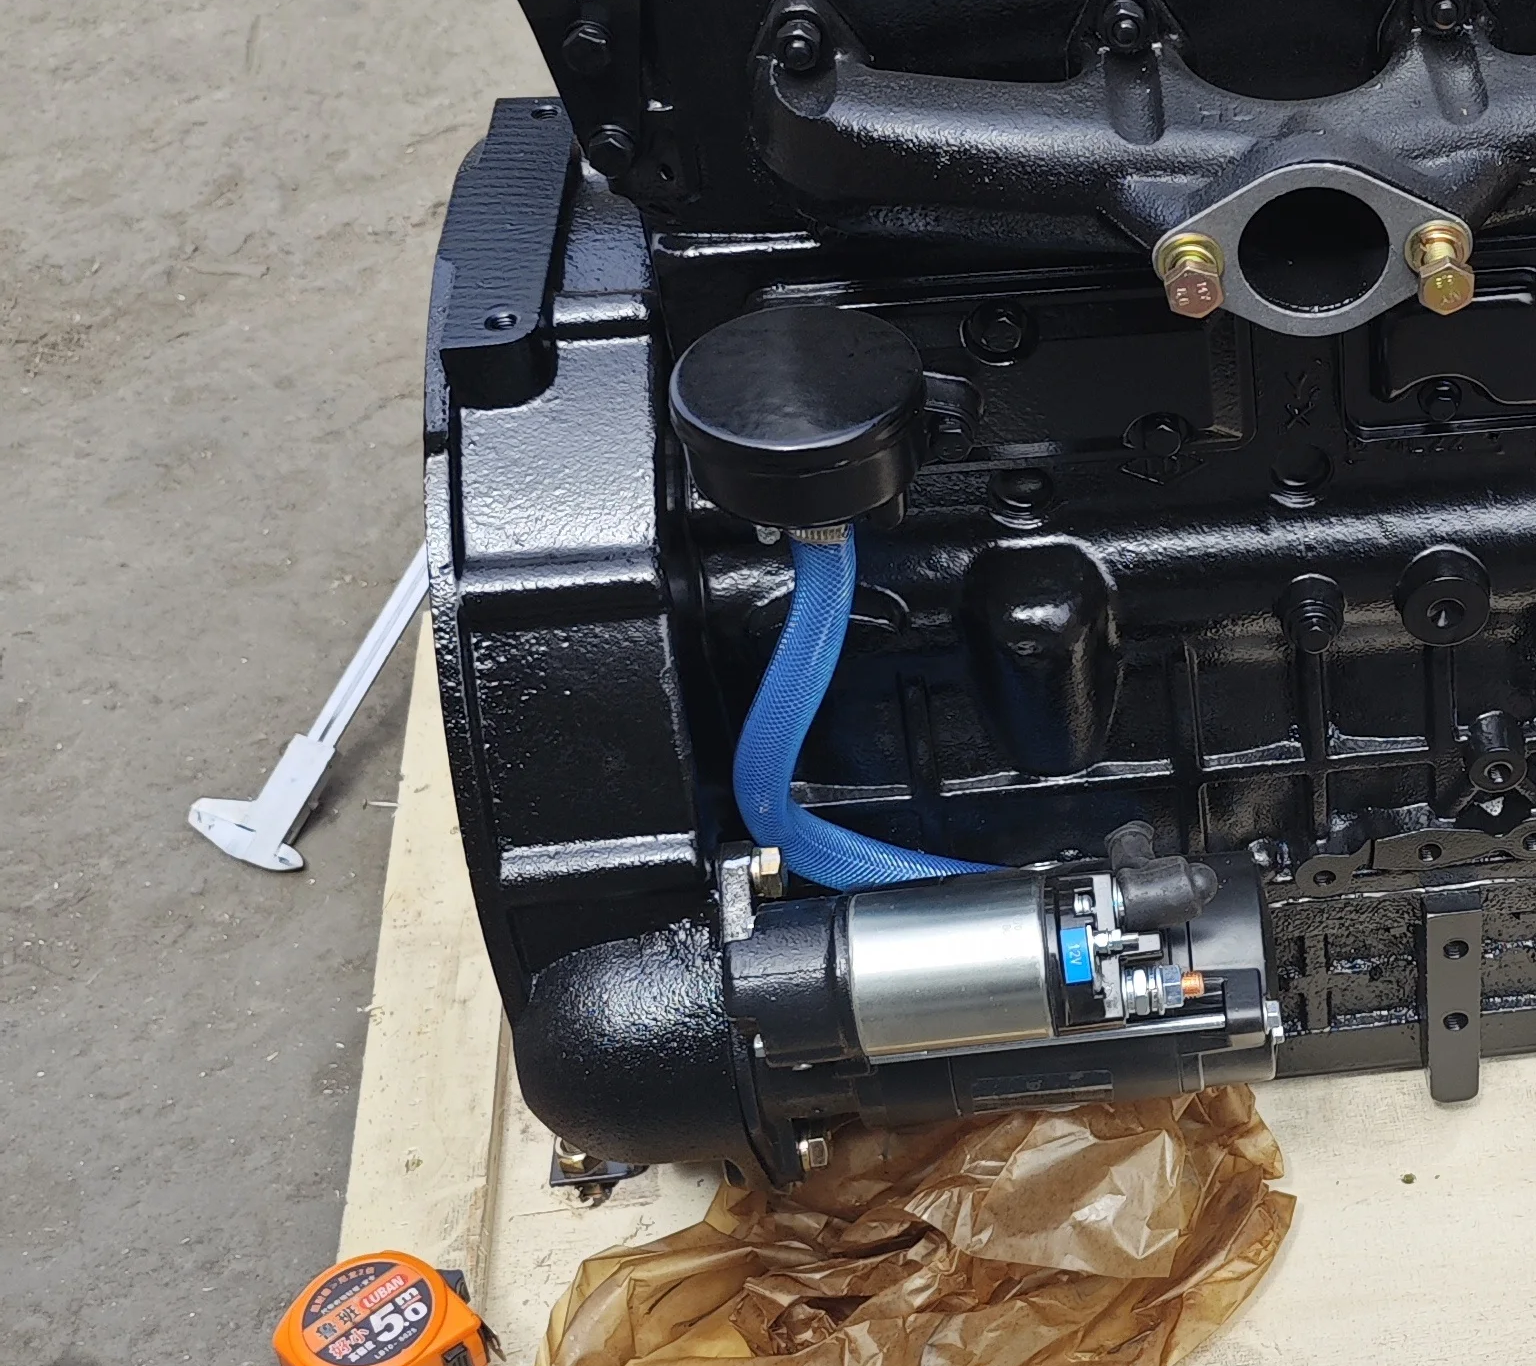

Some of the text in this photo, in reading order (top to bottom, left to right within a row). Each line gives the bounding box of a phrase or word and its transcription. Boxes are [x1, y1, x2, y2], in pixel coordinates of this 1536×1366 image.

[1067, 943, 1083, 966] 12V
[362, 1275, 405, 1308] LUBAN
[369, 1301, 429, 1343] 5.0
